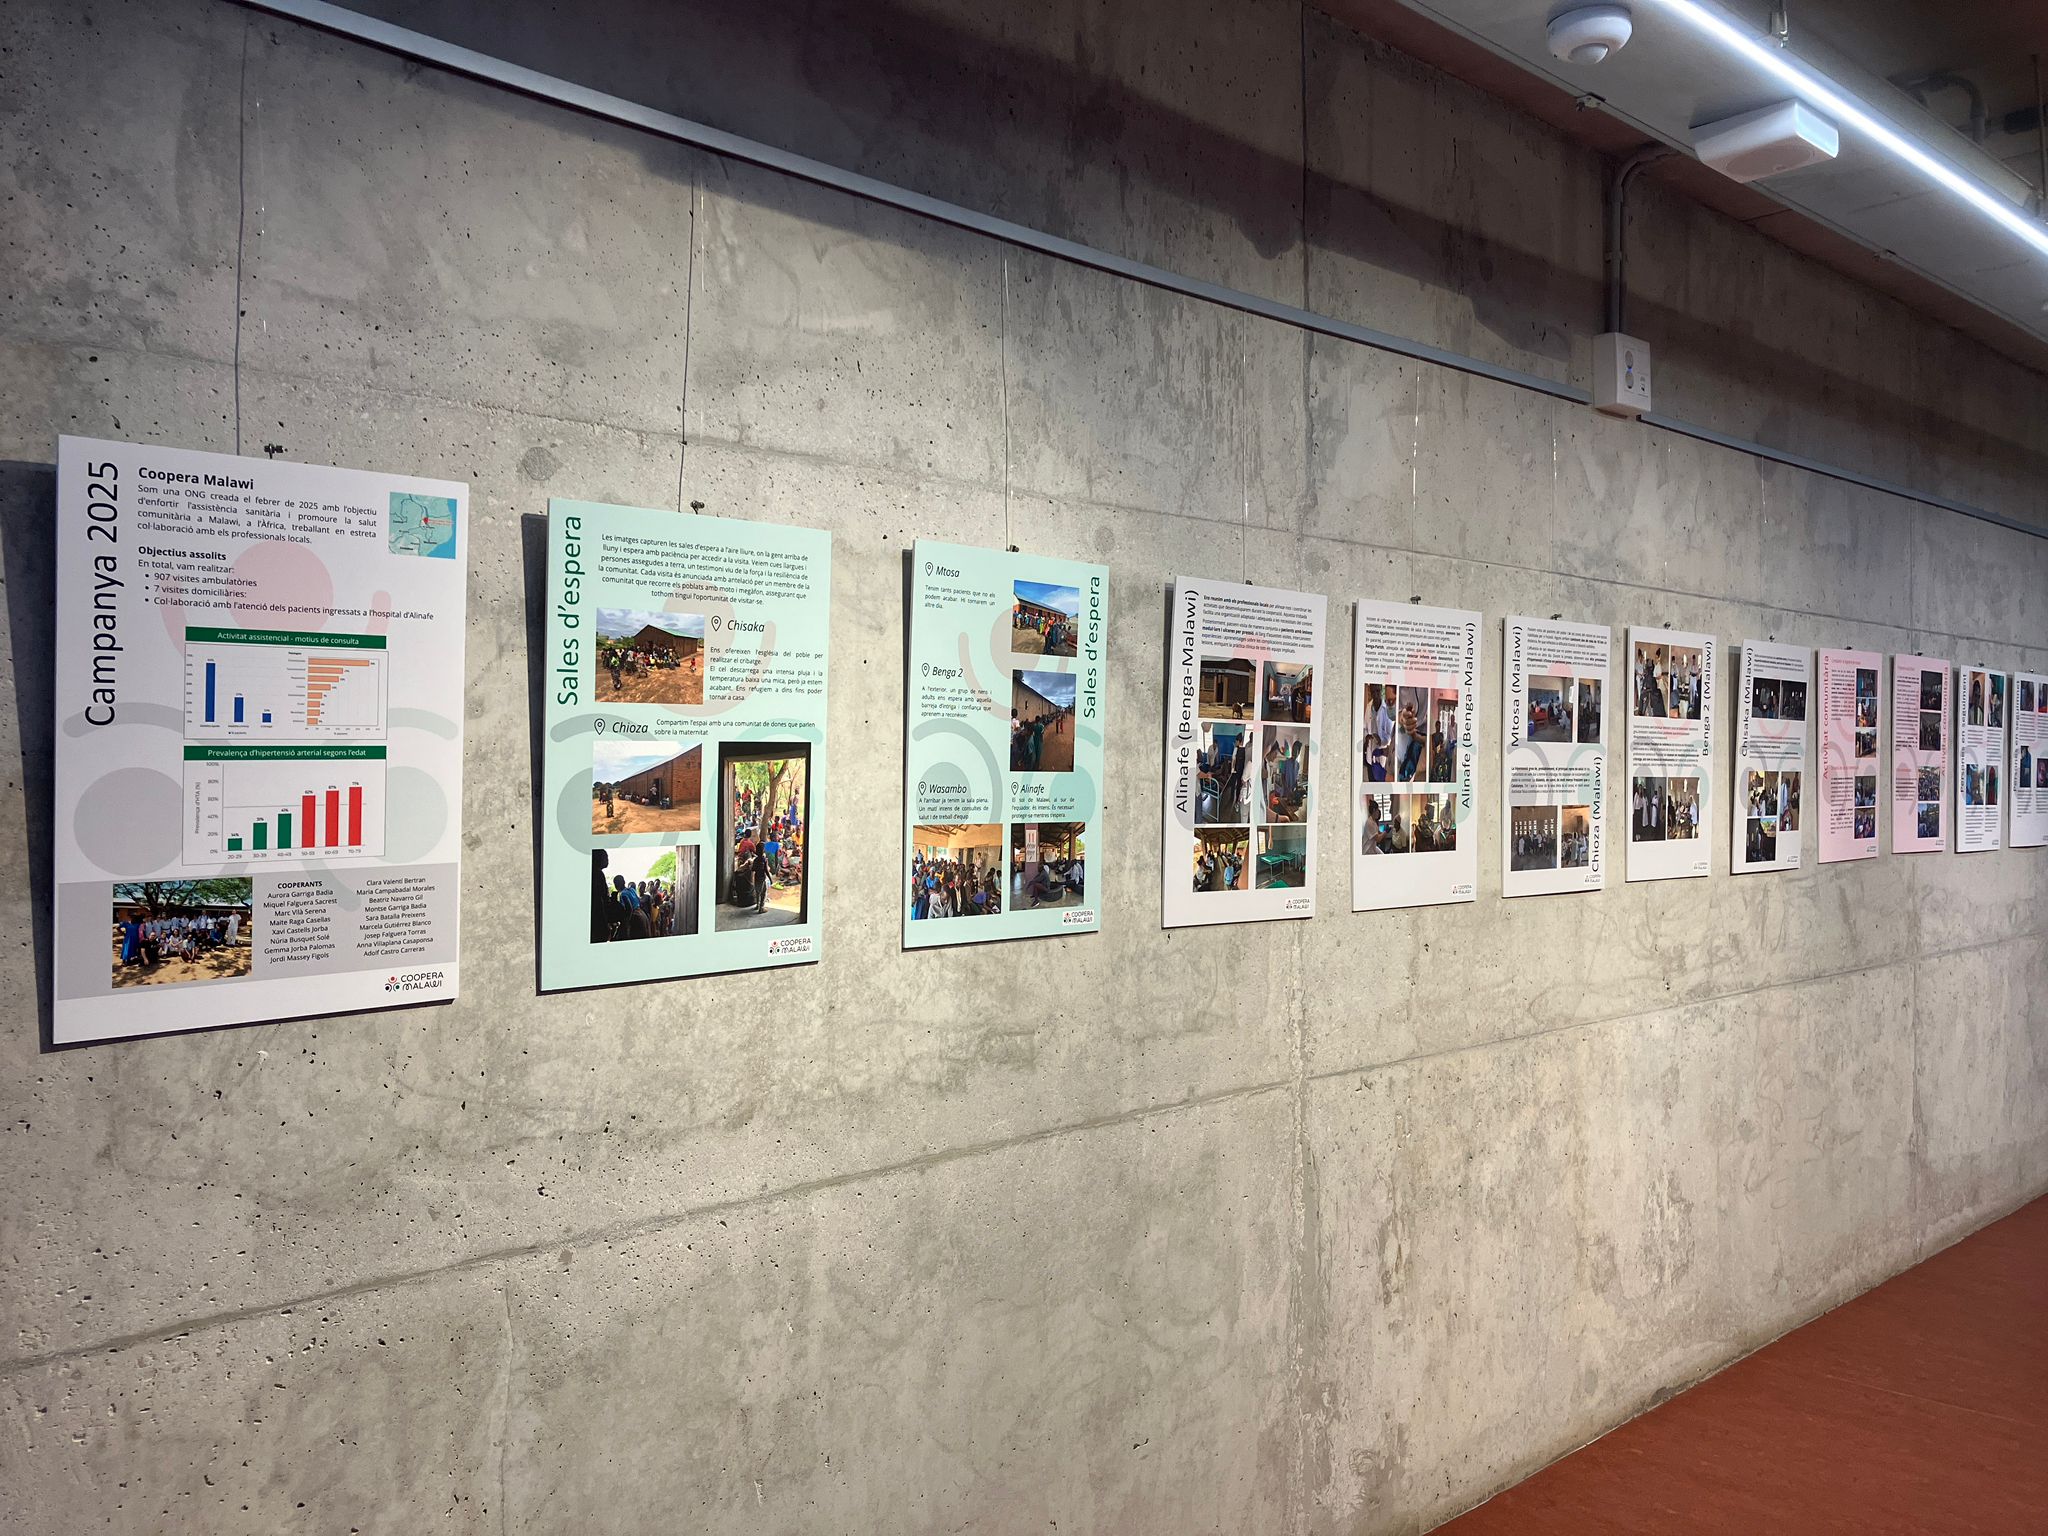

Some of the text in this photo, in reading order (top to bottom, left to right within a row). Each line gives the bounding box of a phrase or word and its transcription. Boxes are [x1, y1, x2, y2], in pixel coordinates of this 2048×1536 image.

[138, 467, 253, 489] Coopera Malawi
[138, 484, 157, 493] Som
[184, 489, 205, 498] ONG
[210, 493, 238, 502] creada
[255, 496, 280, 505] febrer
[284, 499, 294, 507] de
[299, 501, 318, 509] 2025
[344, 505, 376, 515] l'objectiu
[138, 497, 178, 507] d'enfortir
[187, 501, 237, 513] l'assistència
[245, 508, 280, 517] sanitària
[298, 514, 337, 523] promoure
[344, 516, 351, 524] la
[358, 518, 376, 526] salut
[137, 510, 190, 521] comunitària
[209, 515, 240, 526] Malawi,
[257, 518, 286, 530] l'Àfrica,
[292, 524, 329, 533] treballant
[137, 522, 193, 533] col·laboració
[217, 528, 229, 536] els
[231, 530, 285, 541] professionals
[288, 534, 311, 543] locals.
[614, 535, 638, 544] imatges
[694, 544, 719, 552] d'espera
[725, 546, 738, 554] l'aire
[740, 548, 755, 556] lliure,
[138, 546, 226, 560] Objectius assolits
[138, 559, 149, 567] En
[151, 561, 173, 569] total,
[197, 564, 233, 573] realitzar:
[936, 566, 959, 577] Mtosa
[154, 572, 256, 586] 907 visites ambulatòries
[84, 461, 124, 727] Campanya 2025
[161, 586, 189, 594] visites
[191, 587, 246, 597] domiciliàries:
[154, 597, 210, 607] Col·laboració
[233, 602, 267, 610] l'atenció
[322, 607, 360, 616] ingressats
[369, 609, 401, 618] l'hospital
[403, 611, 433, 619] d'Alinafe
[557, 516, 585, 706] Sales d'espera
[727, 620, 764, 632] Chisaka
[1084, 576, 1102, 719] Sales d'espera
[932, 666, 956, 679] Benga
[1511, 625, 1522, 747] Mtosa (Malawi)
[1176, 589, 1199, 813] Alinafe (Benga-Malawi)
[1702, 641, 1713, 756] Benga 2 (Malawi)
[1741, 647, 1753, 757] Chisaka (Malawi)
[1461, 622, 1476, 808] Alinafe (Benga-Malawi)
[612, 722, 648, 733] Chioza
[929, 784, 967, 793] Wasambo
[1020, 784, 1044, 794] Alinafe
[1592, 756, 1602, 820] (Malawi)
[1591, 825, 1600, 872] Chioza
[277, 881, 322, 889] COOPERANTS
[263, 900, 285, 909] Miquel
[286, 926, 310, 934] Castells
[311, 925, 328, 933] Jorba
[290, 945, 307, 953] Jorba
[781, 938, 811, 947] COOPERA
[270, 956, 285, 964] Jordi
[311, 952, 329, 960] Figols
[400, 971, 443, 982] COOPERA
[402, 980, 441, 990] MALAWI
